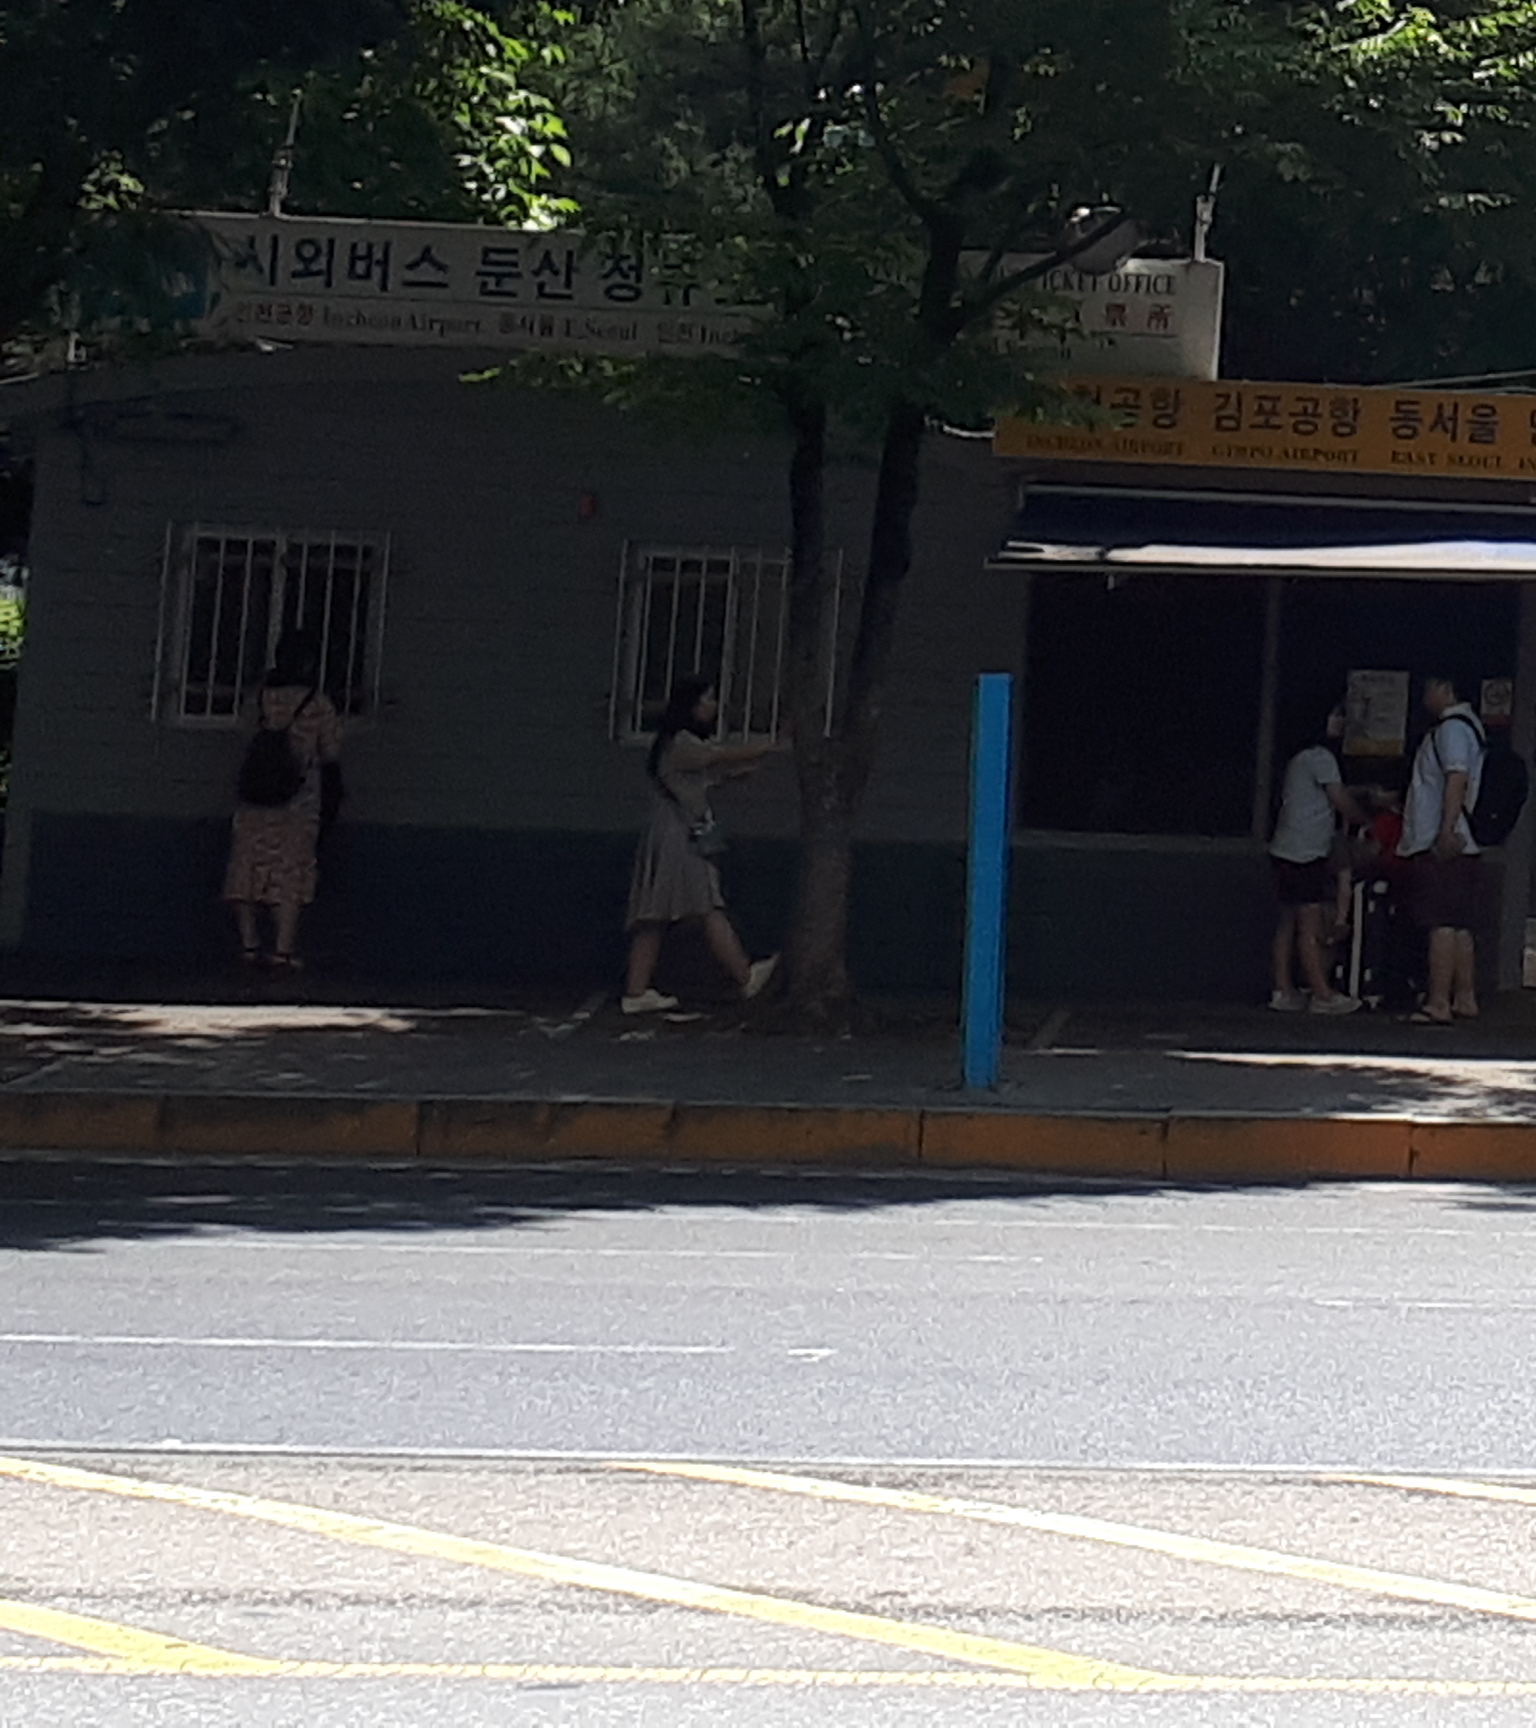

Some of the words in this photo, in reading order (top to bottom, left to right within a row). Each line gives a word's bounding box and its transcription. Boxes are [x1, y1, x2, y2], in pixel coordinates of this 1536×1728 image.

[232, 234, 450, 292] 시외버스
[475, 246, 574, 301] 둔산
[1040, 271, 1099, 292] ICKET
[1107, 274, 1177, 296] OFFICE
[1214, 391, 1363, 439] 김포공항
[1389, 399, 1500, 445] 동서울
